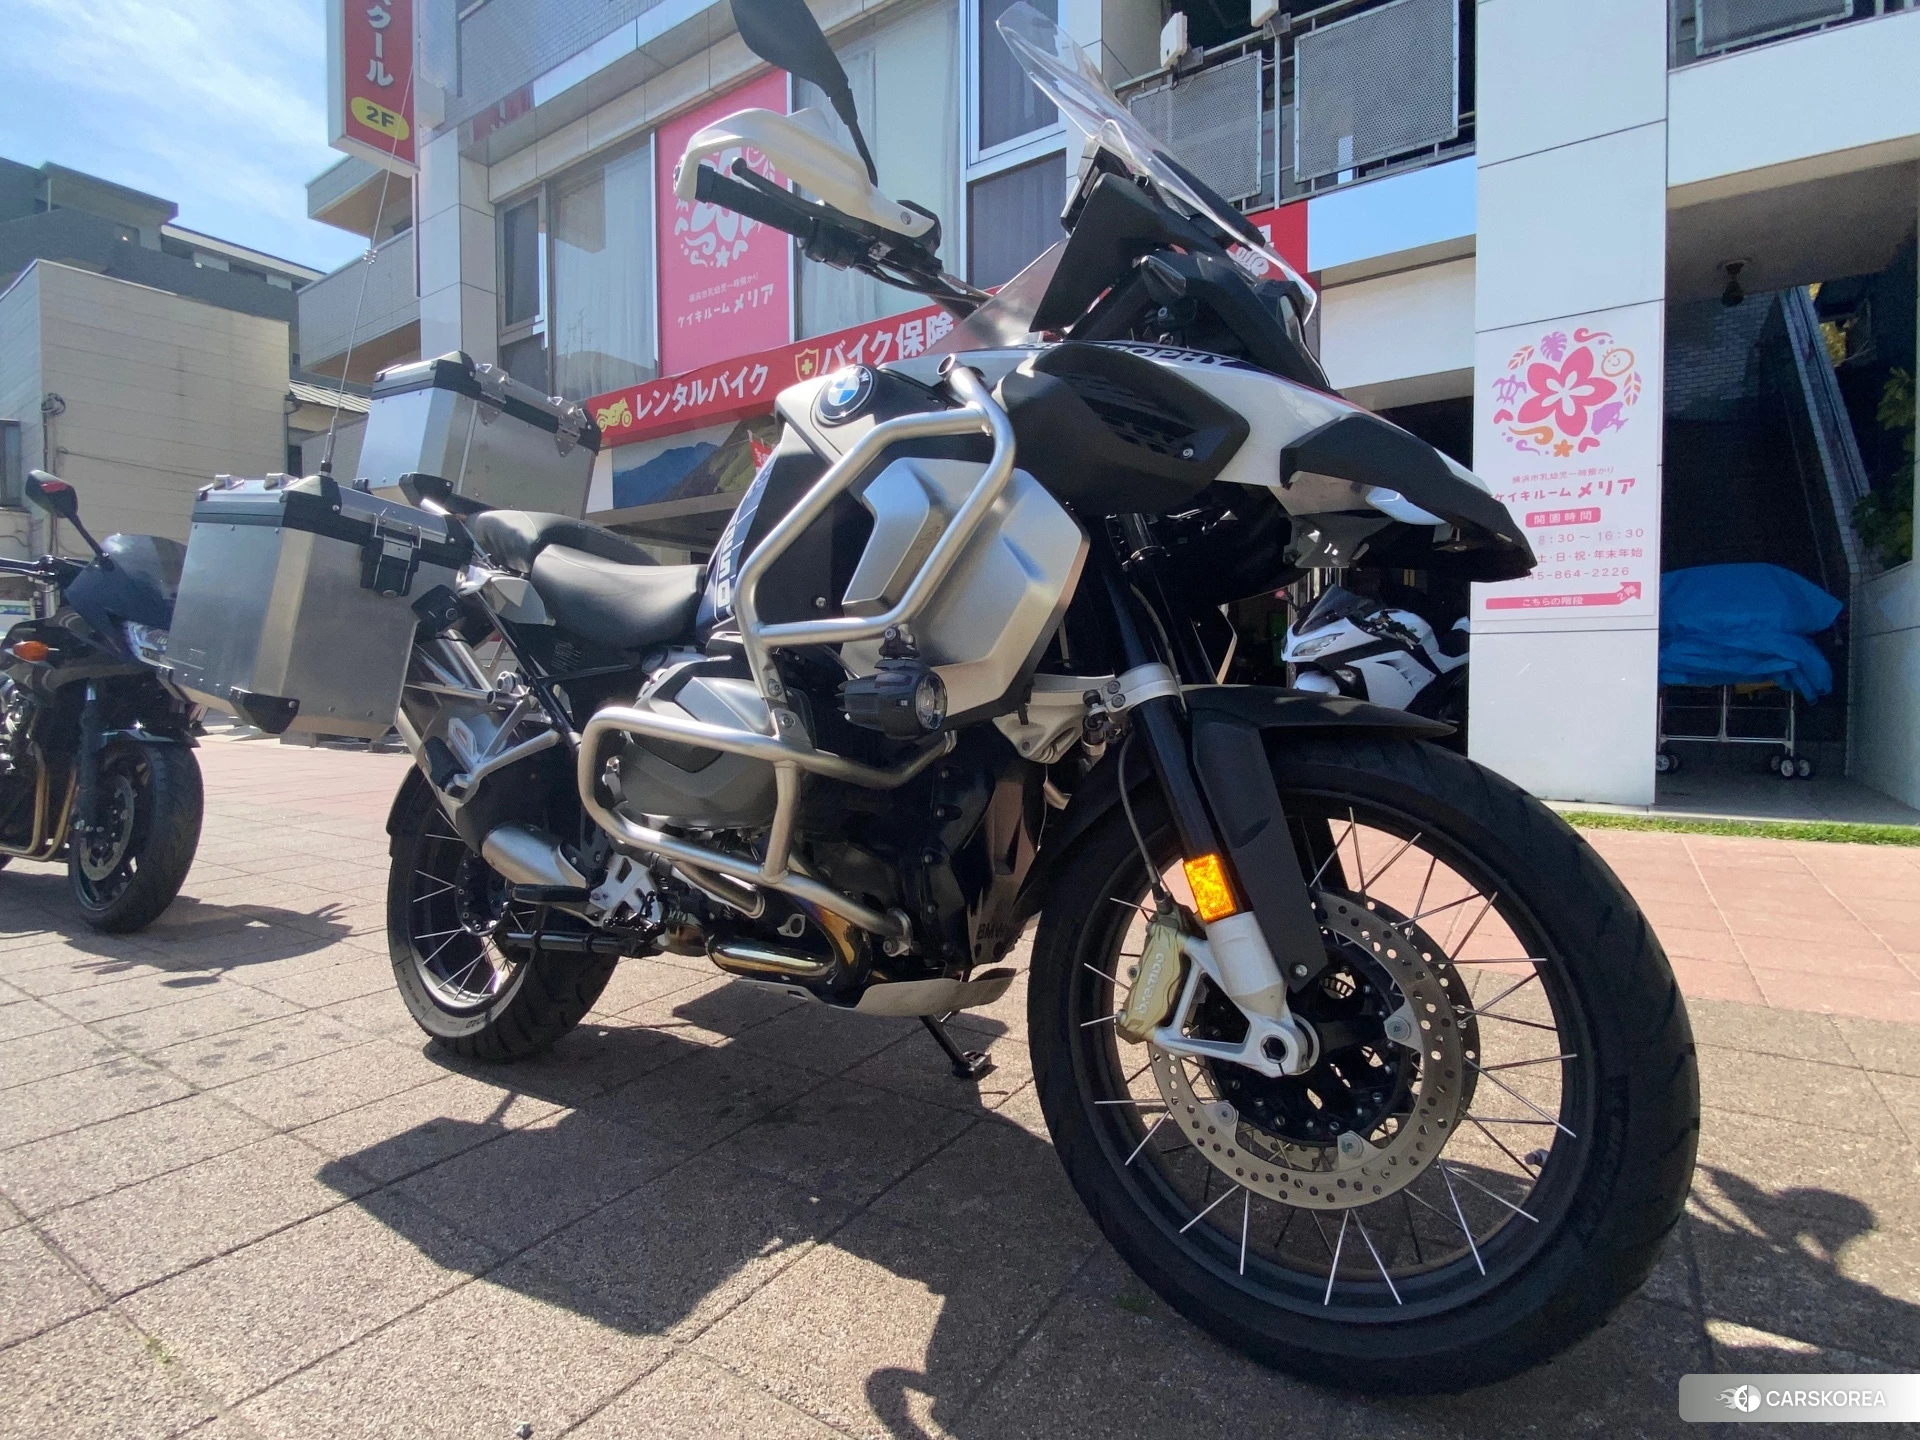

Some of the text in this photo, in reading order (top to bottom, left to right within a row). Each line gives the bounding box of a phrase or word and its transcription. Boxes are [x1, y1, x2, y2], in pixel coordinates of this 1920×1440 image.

[366, 0, 394, 86] クール
[366, 105, 395, 128] 2F
[636, 311, 954, 420] レンタルバイク バイク保険
[1519, 566, 1630, 581] 45-864-2226
[1522, 596, 1584, 607] こちらの階段
[1136, 952, 1165, 1015] brembo
